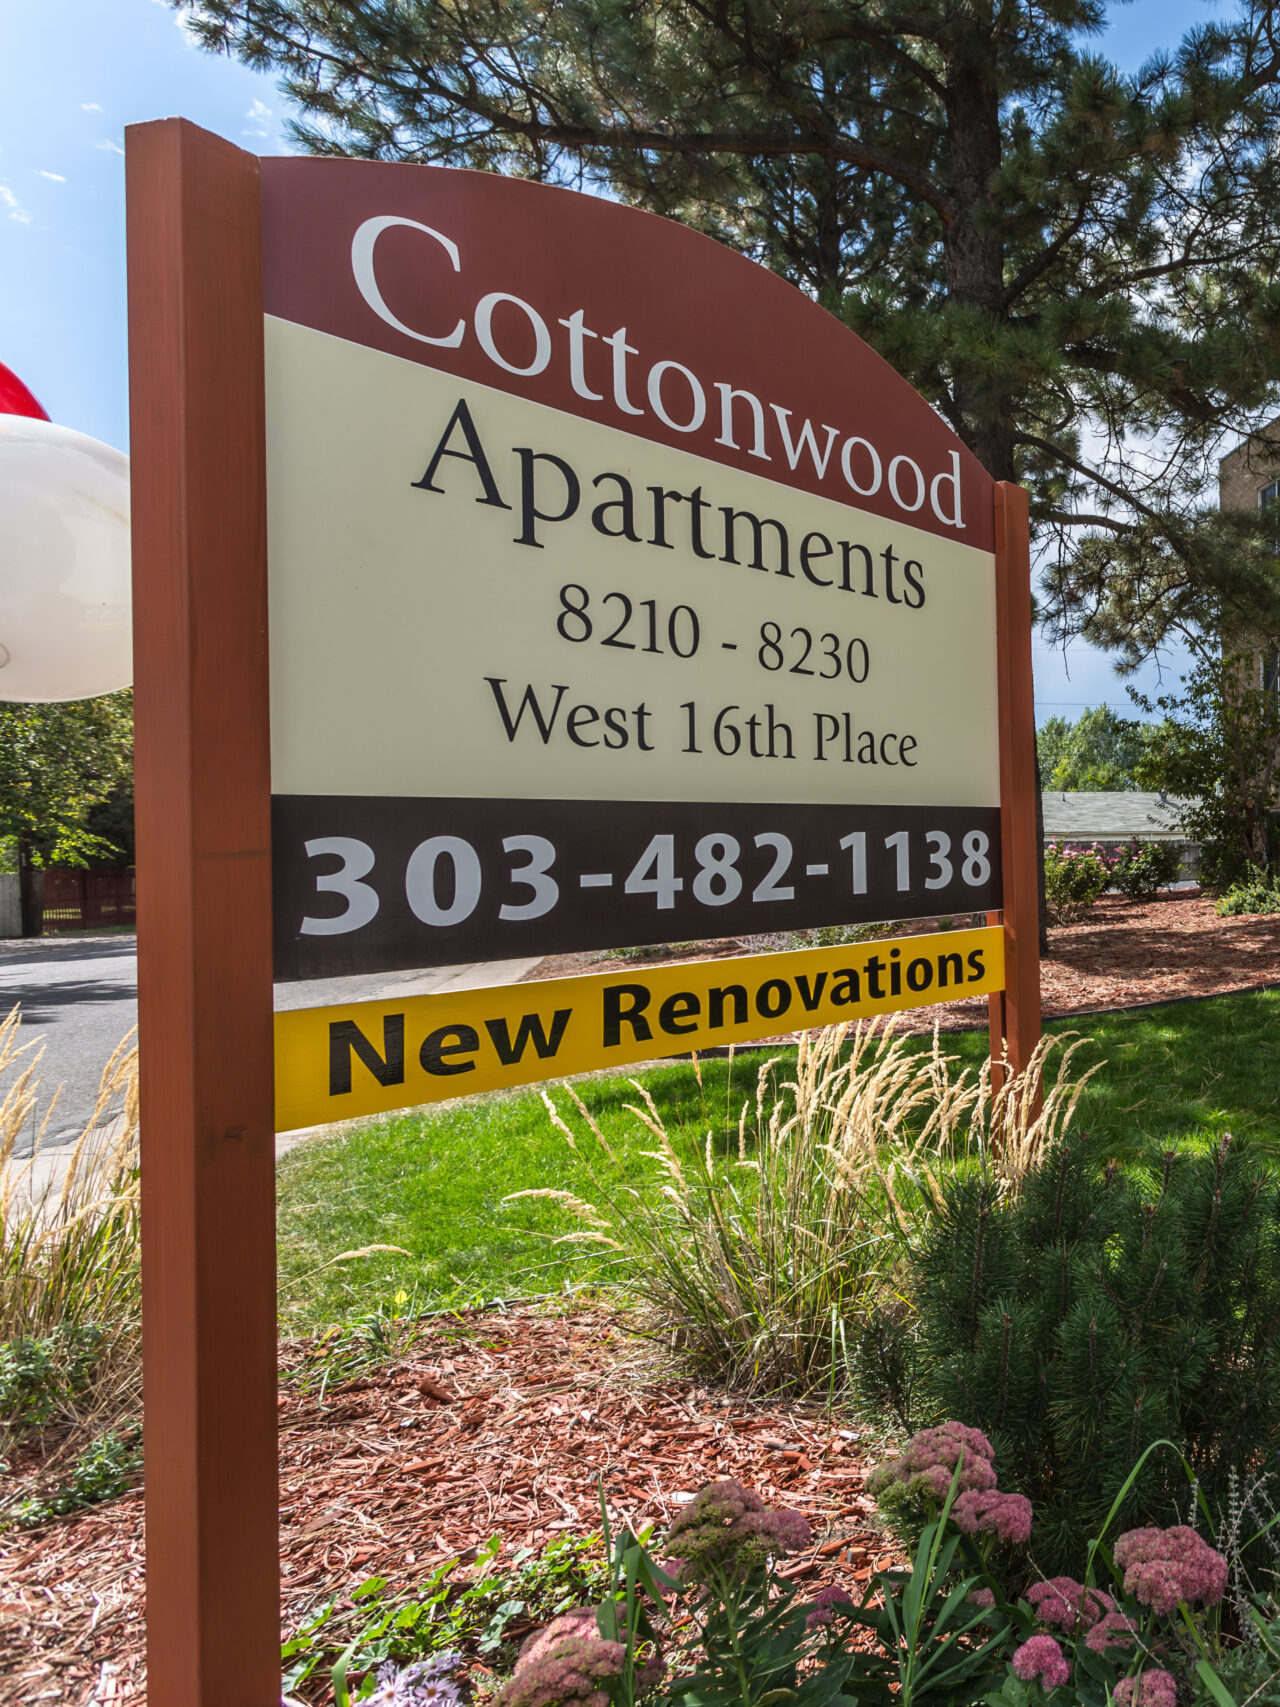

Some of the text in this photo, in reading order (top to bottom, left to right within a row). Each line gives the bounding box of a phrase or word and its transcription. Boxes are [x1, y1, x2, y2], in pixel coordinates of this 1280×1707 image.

[351, 215, 966, 529] Cottonwood
[411, 398, 926, 609] Apartments
[557, 583, 870, 683] 8210 - 8230
[484, 677, 918, 767] West 16th Place
[299, 830, 992, 936] 303-482-1138
[329, 947, 986, 1097] New Renovations
